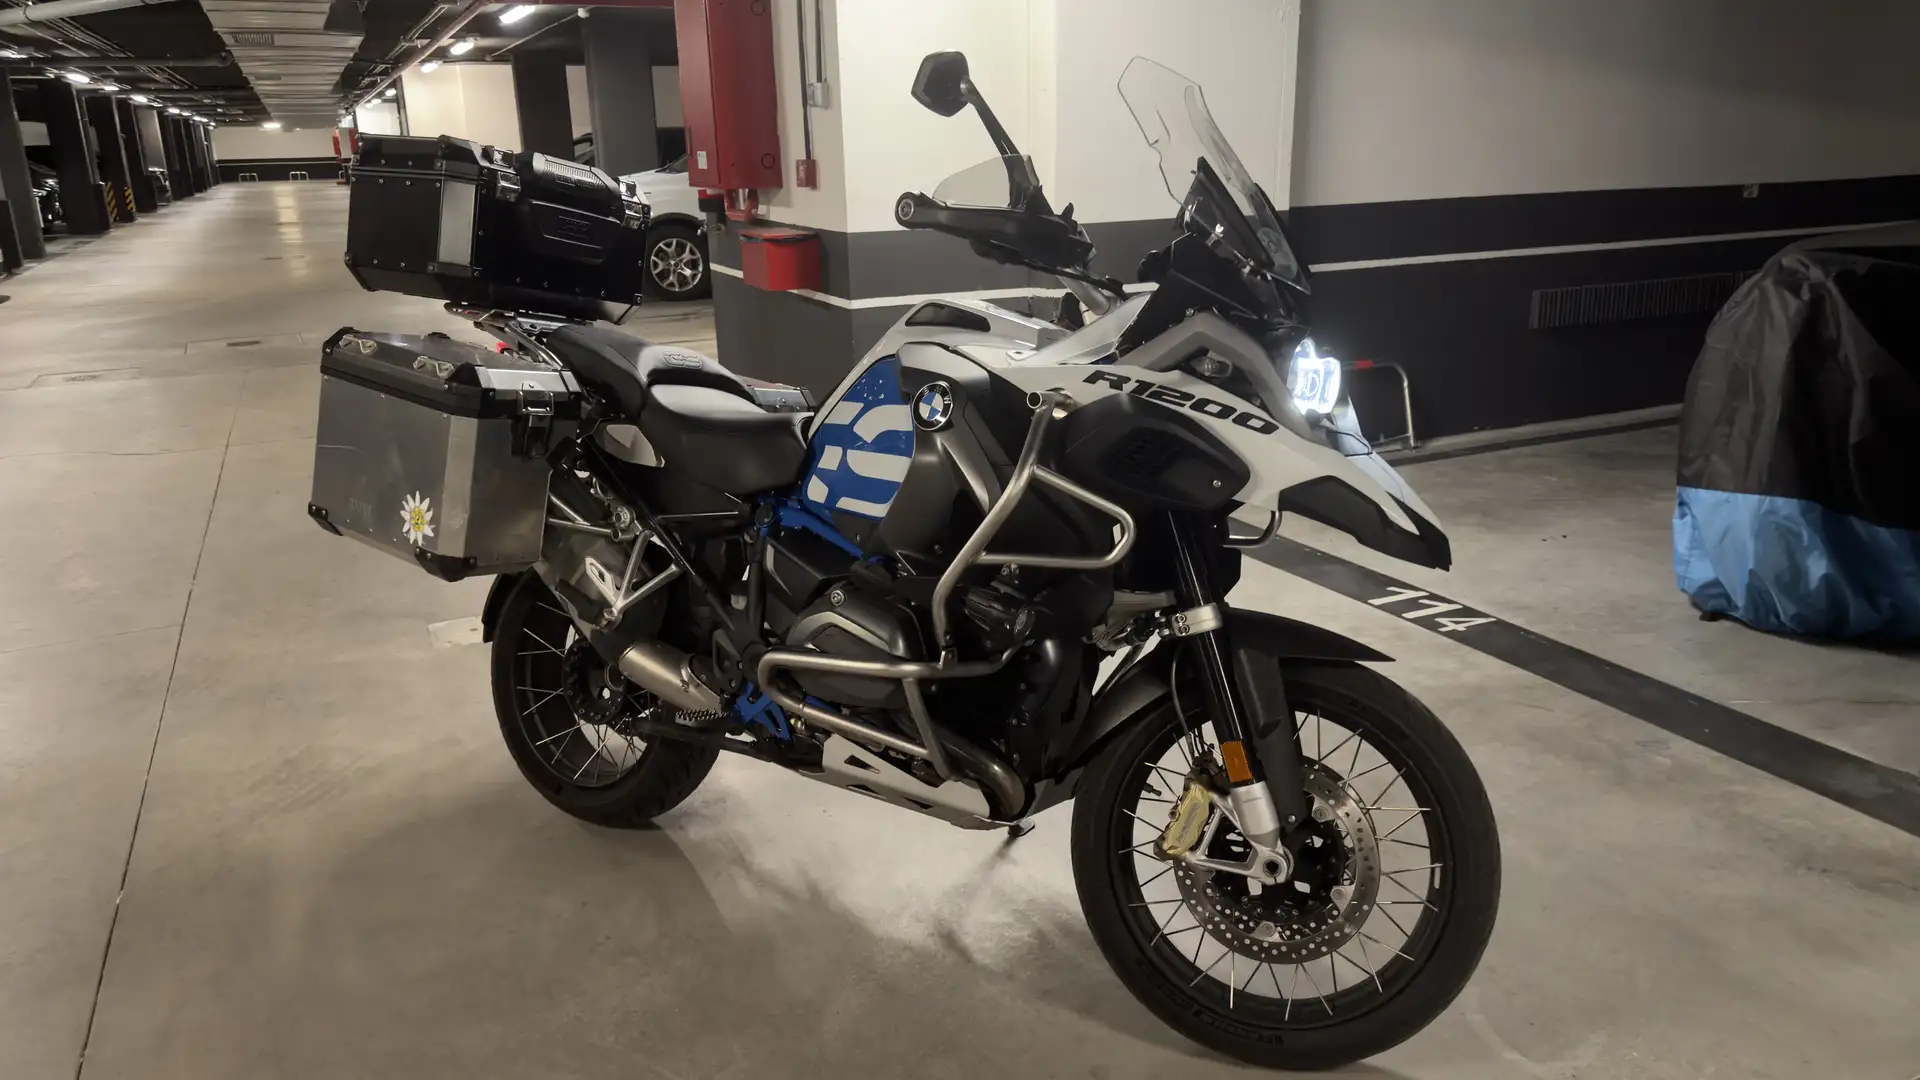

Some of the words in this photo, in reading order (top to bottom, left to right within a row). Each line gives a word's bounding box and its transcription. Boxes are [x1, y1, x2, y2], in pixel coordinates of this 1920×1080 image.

[662, 352, 703, 369] GS
[1082, 369, 1280, 435] R1200
[1367, 586, 1498, 632] 114
